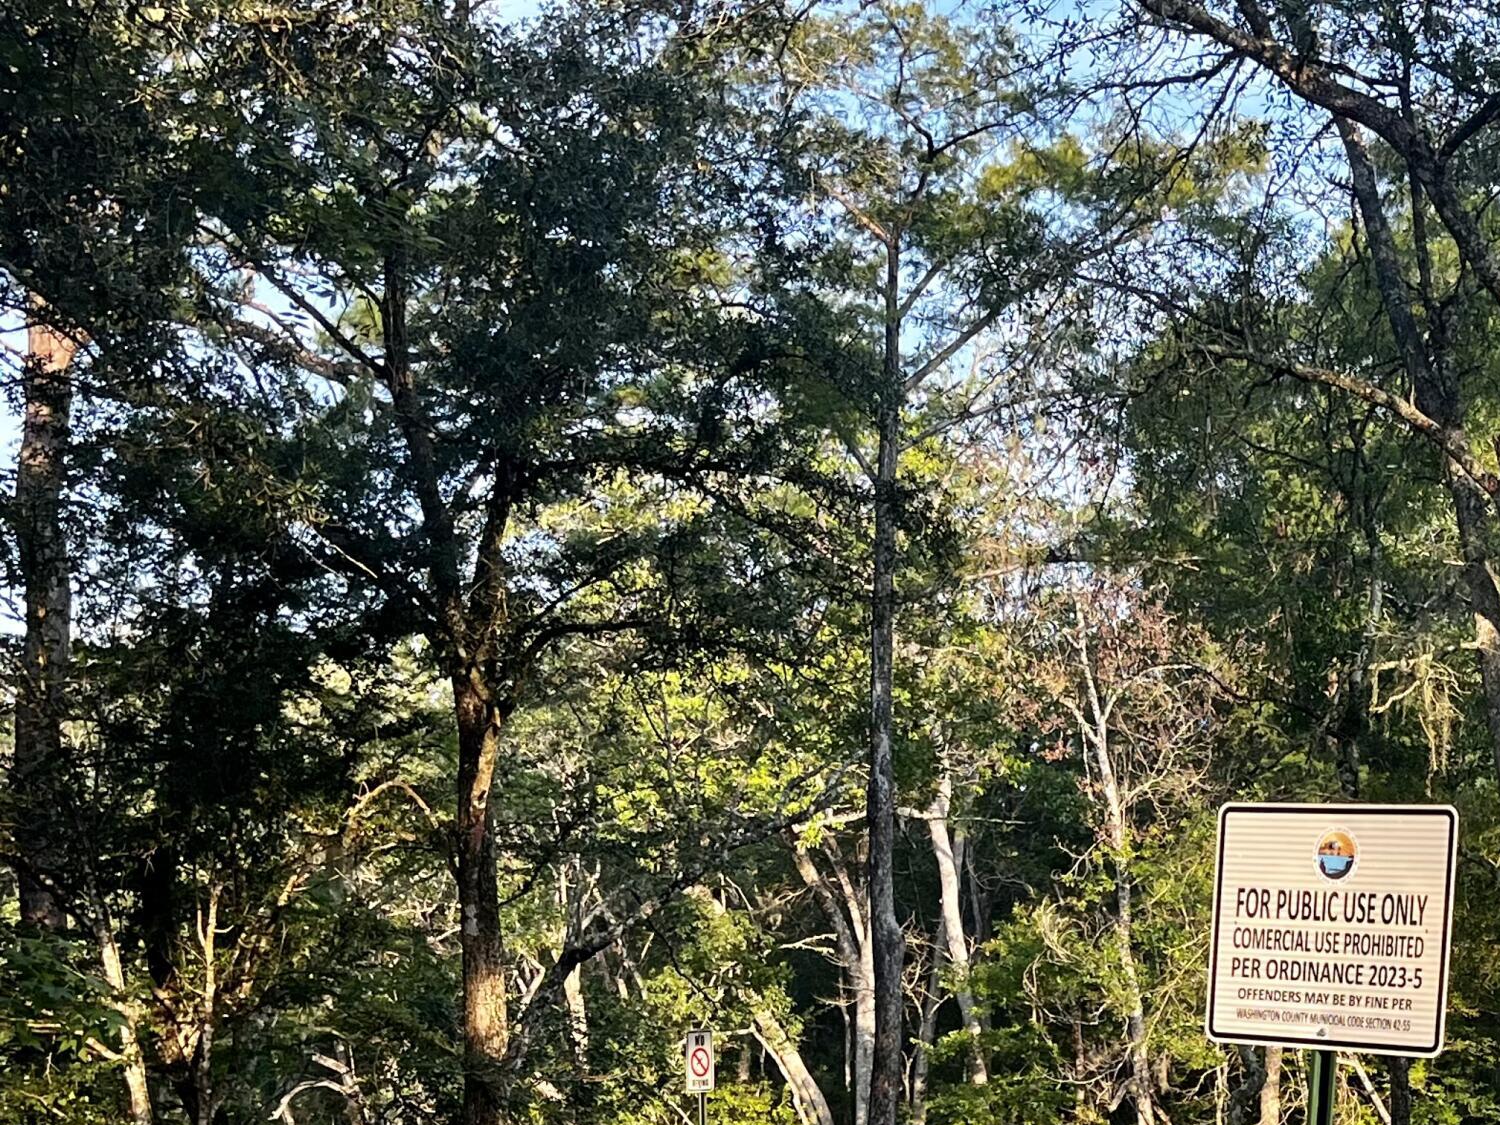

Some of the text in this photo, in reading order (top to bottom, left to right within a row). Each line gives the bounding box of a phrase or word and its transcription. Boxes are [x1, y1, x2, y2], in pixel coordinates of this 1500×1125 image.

[1236, 888, 1428, 926] FOR PUBLIC USE ONLY
[1233, 927, 1424, 958] COMERCIAL USE PROHIBITED
[1231, 957, 1423, 989] PER ORDINANCE 2023-5
[1238, 988, 1413, 1011] OFFENDERS MAY BE BY FINE PER
[1236, 1008, 1280, 1022] WASHINGTON
[1282, 1011, 1309, 1024] COUNTY
[1347, 1015, 1364, 1029] CODE
[1365, 1017, 1392, 1030] SECTION
